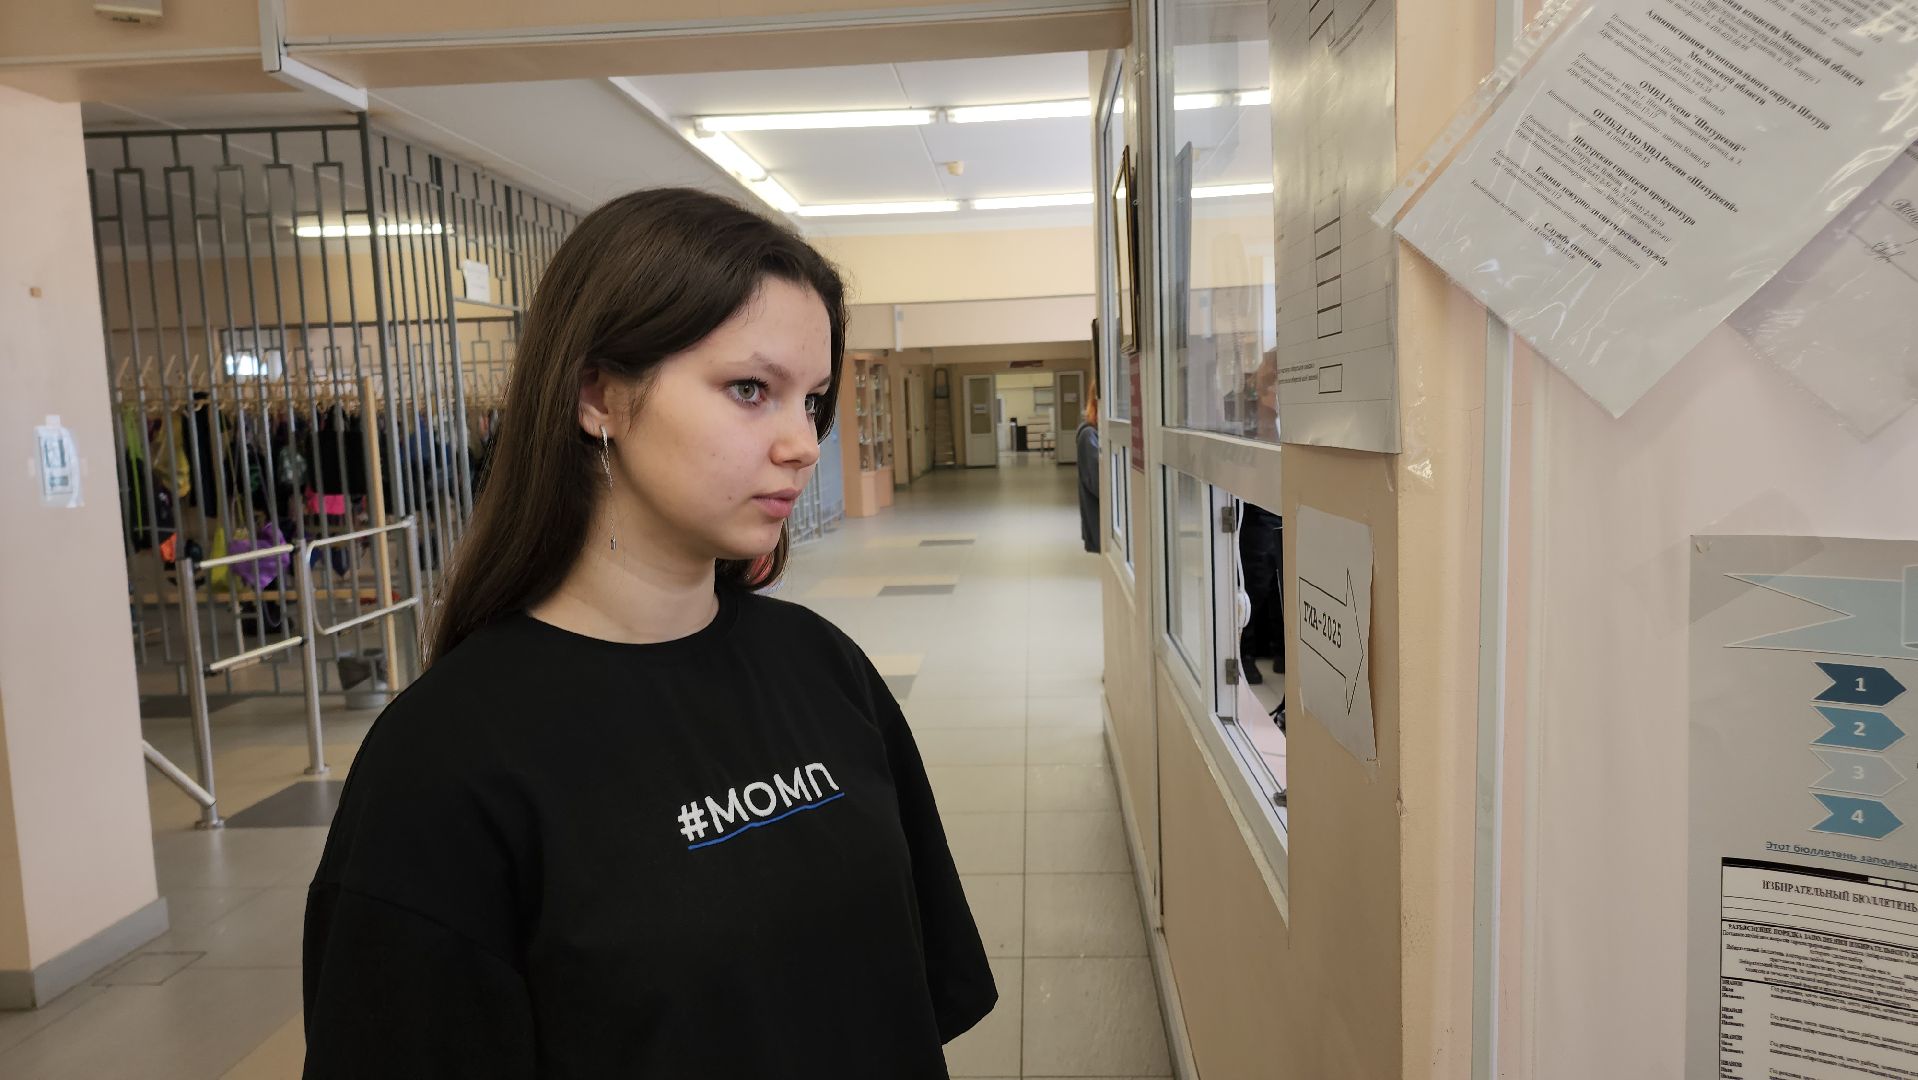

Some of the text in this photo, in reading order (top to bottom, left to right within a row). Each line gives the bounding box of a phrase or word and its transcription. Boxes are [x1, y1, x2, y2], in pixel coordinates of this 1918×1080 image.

[1648, 10, 1705, 50] Администрация
[1706, 48, 1769, 92] муниципального
[1769, 90, 1797, 110] округа
[1797, 106, 1830, 130] Шатура
[1688, 51, 1735, 85] Московской
[1734, 83, 1766, 106] области
[1781, 31, 1831, 66] Московской
[1830, 63, 1864, 86] области
[1639, 81, 1666, 101] ОМВД
[1665, 97, 1691, 118] России
[1593, 109, 1627, 136] ОГИБДД
[1626, 132, 1642, 145] МО
[1642, 142, 1662, 160] МВД
[1660, 155, 1687, 177] России
[1573, 135, 1613, 166] Шатурская
[1612, 164, 1649, 192] городская
[1648, 190, 1696, 225] прокуратура
[1535, 166, 1561, 188] Единая
[1559, 187, 1642, 247] дежурно-диспетчерская
[1641, 245, 1668, 267] служба
[1544, 222, 1602, 269] Служба спасения
[1855, 677, 1867, 692] 1
[1853, 721, 1867, 737] 2
[1852, 765, 1865, 780] 3
[1851, 809, 1864, 824] 4
[1766, 841, 1790, 851] Этот
[1793, 845, 1857, 861] бюллетень
[1762, 879, 1918, 913] ИЗБИРАТЕЛЬНЫЙ БЮЛЛЕТЕНЬ
